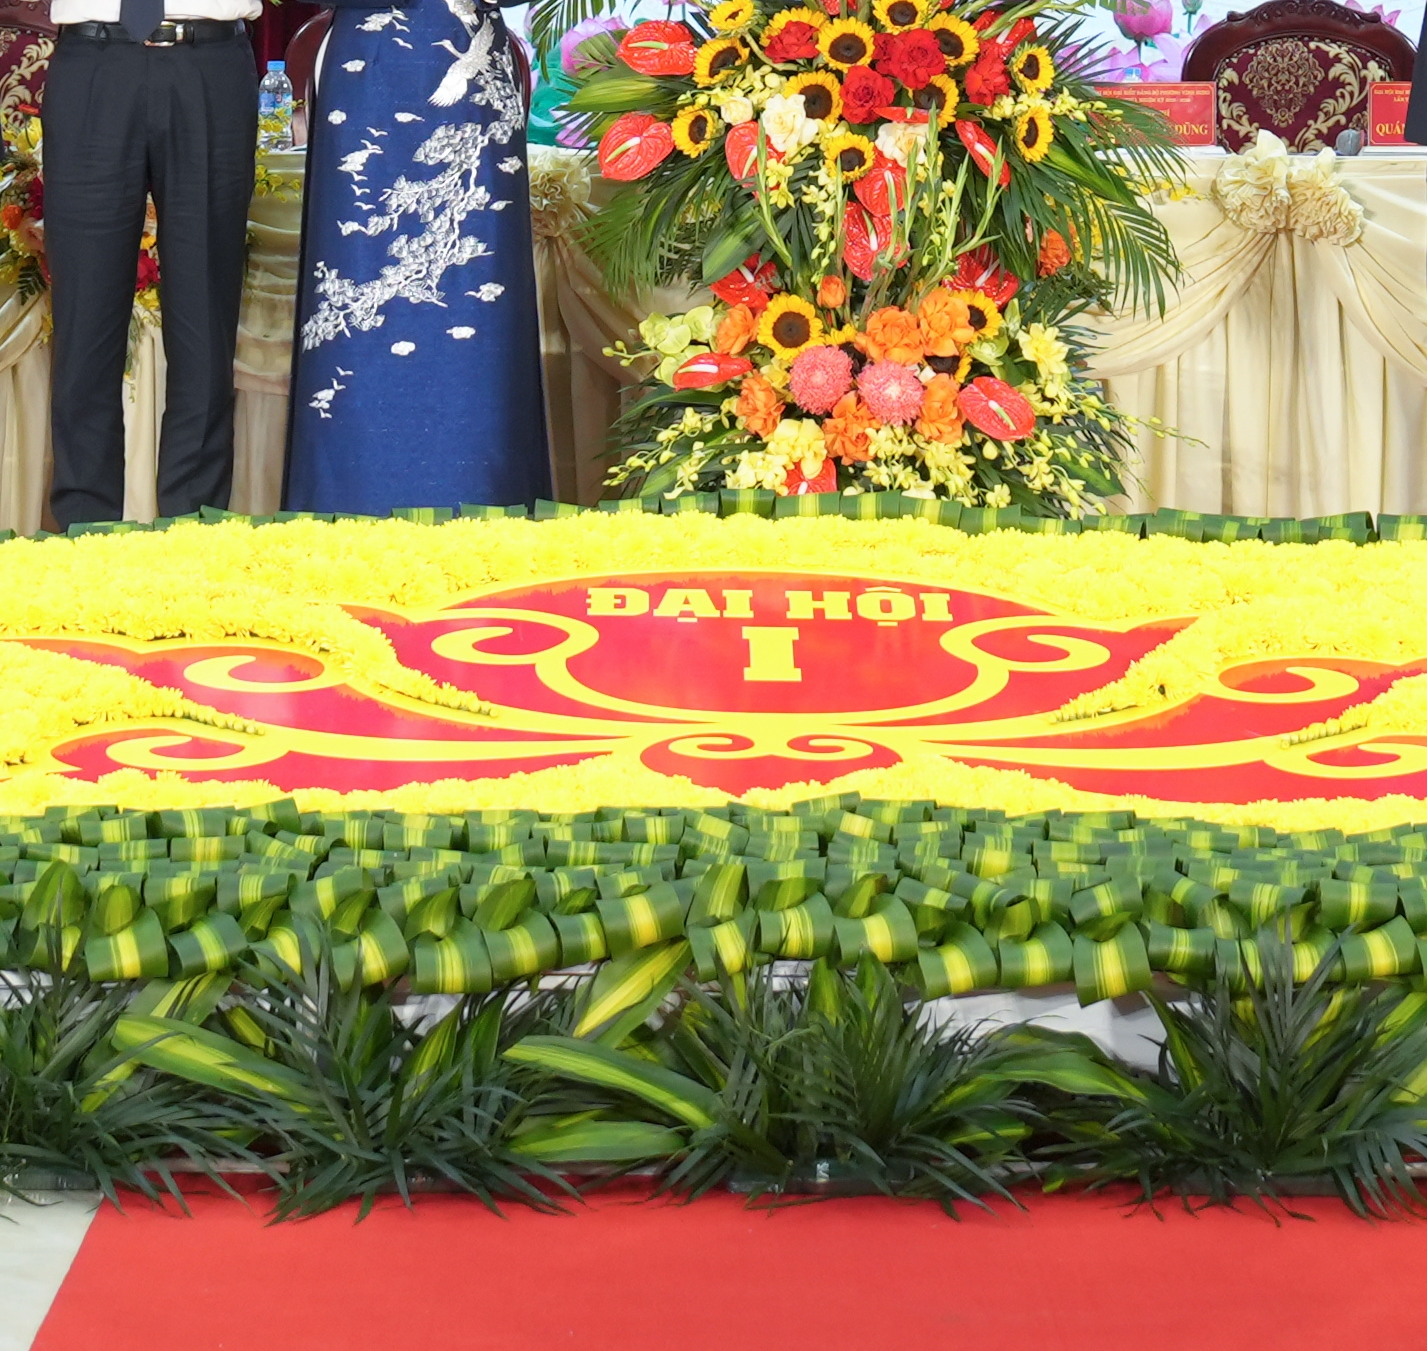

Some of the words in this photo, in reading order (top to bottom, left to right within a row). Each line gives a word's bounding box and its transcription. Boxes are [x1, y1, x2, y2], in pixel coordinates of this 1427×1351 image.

[585, 586, 755, 624] ĐẠI
[784, 585, 955, 627] HỘI
[741, 625, 803, 682] I
